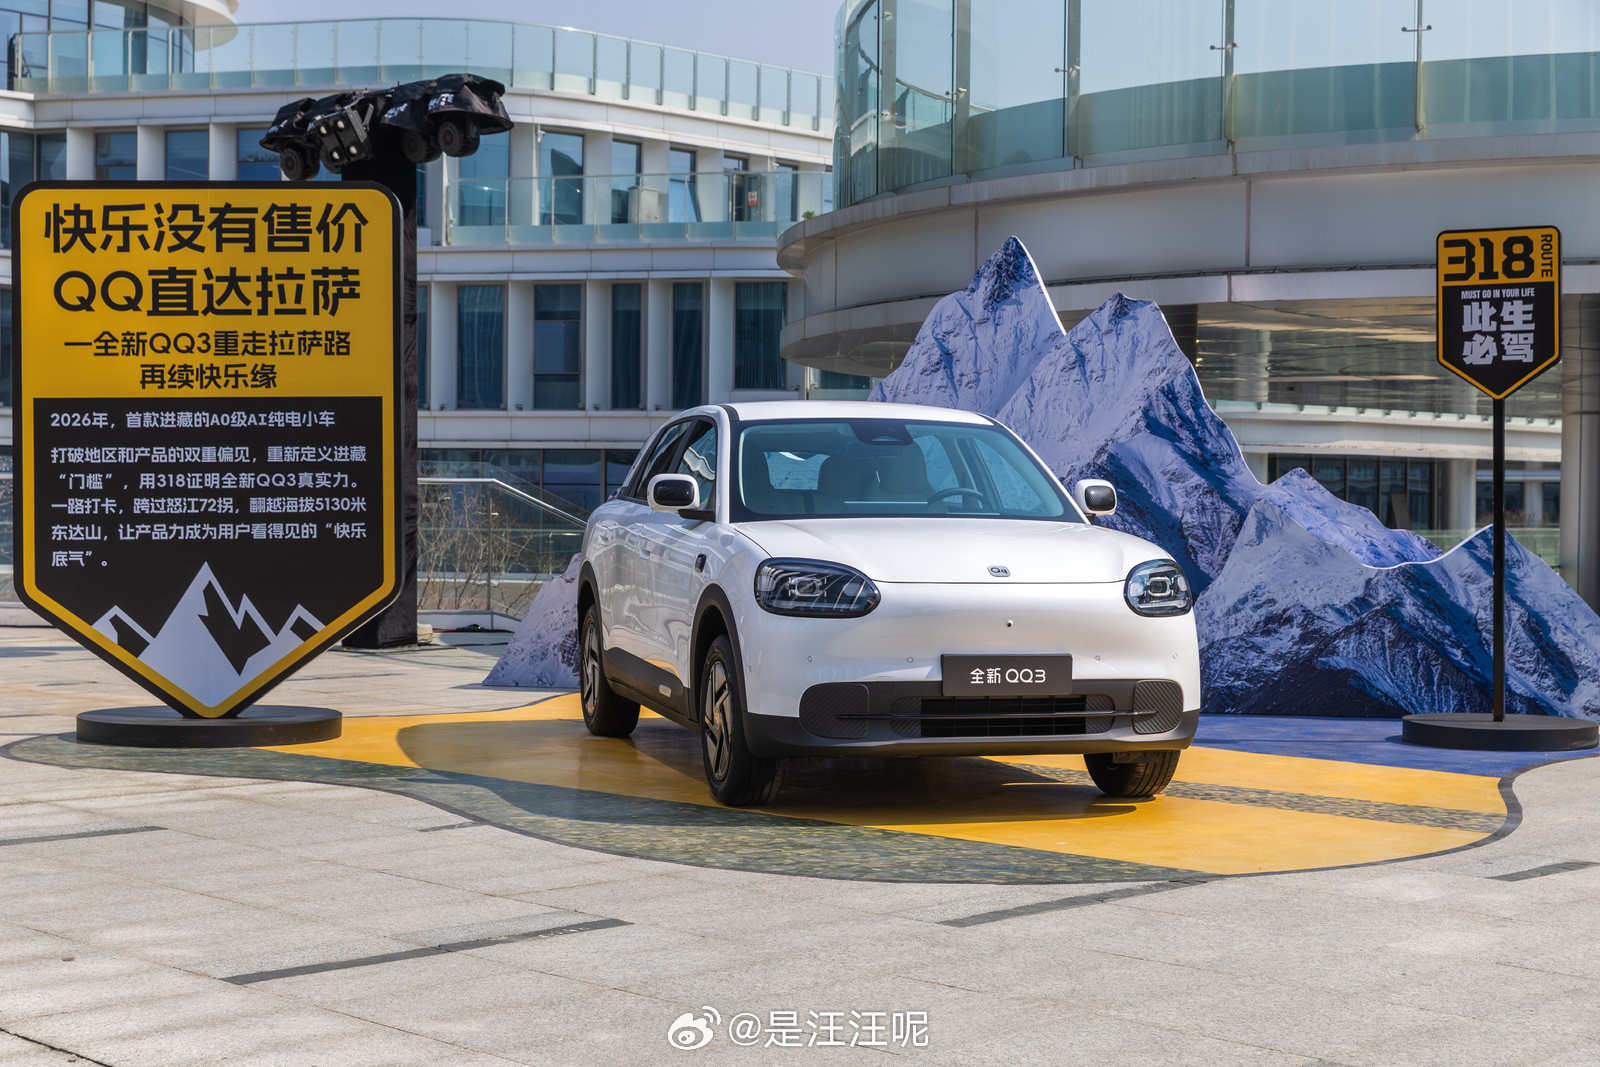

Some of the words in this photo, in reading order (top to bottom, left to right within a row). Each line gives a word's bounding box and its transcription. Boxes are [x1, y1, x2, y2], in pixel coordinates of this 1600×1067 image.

[44, 202, 369, 254] 快乐没有售价
[1443, 235, 1535, 282] 318
[1541, 234, 1553, 278] ROUTE
[53, 266, 361, 317] QQ直达拉萨
[1461, 290, 1480, 300] MUST
[1482, 289, 1492, 299] GO
[1493, 289, 1500, 298] IN
[1501, 288, 1520, 298] YOUR
[1521, 287, 1535, 297] LIFE
[1462, 300, 1536, 333] 此生
[1462, 332, 1534, 366] 必驾
[139, 363, 278, 390] 再续快乐缘
[50, 446, 367, 464] 打破地区和产品的双重偏见，重新定义进藏
[51, 497, 367, 515] 一路打卡，跨过怒江72拐，翻越海拔5130米
[970, 668, 1001, 684] 全新
[1005, 668, 1046, 683] QQ3
